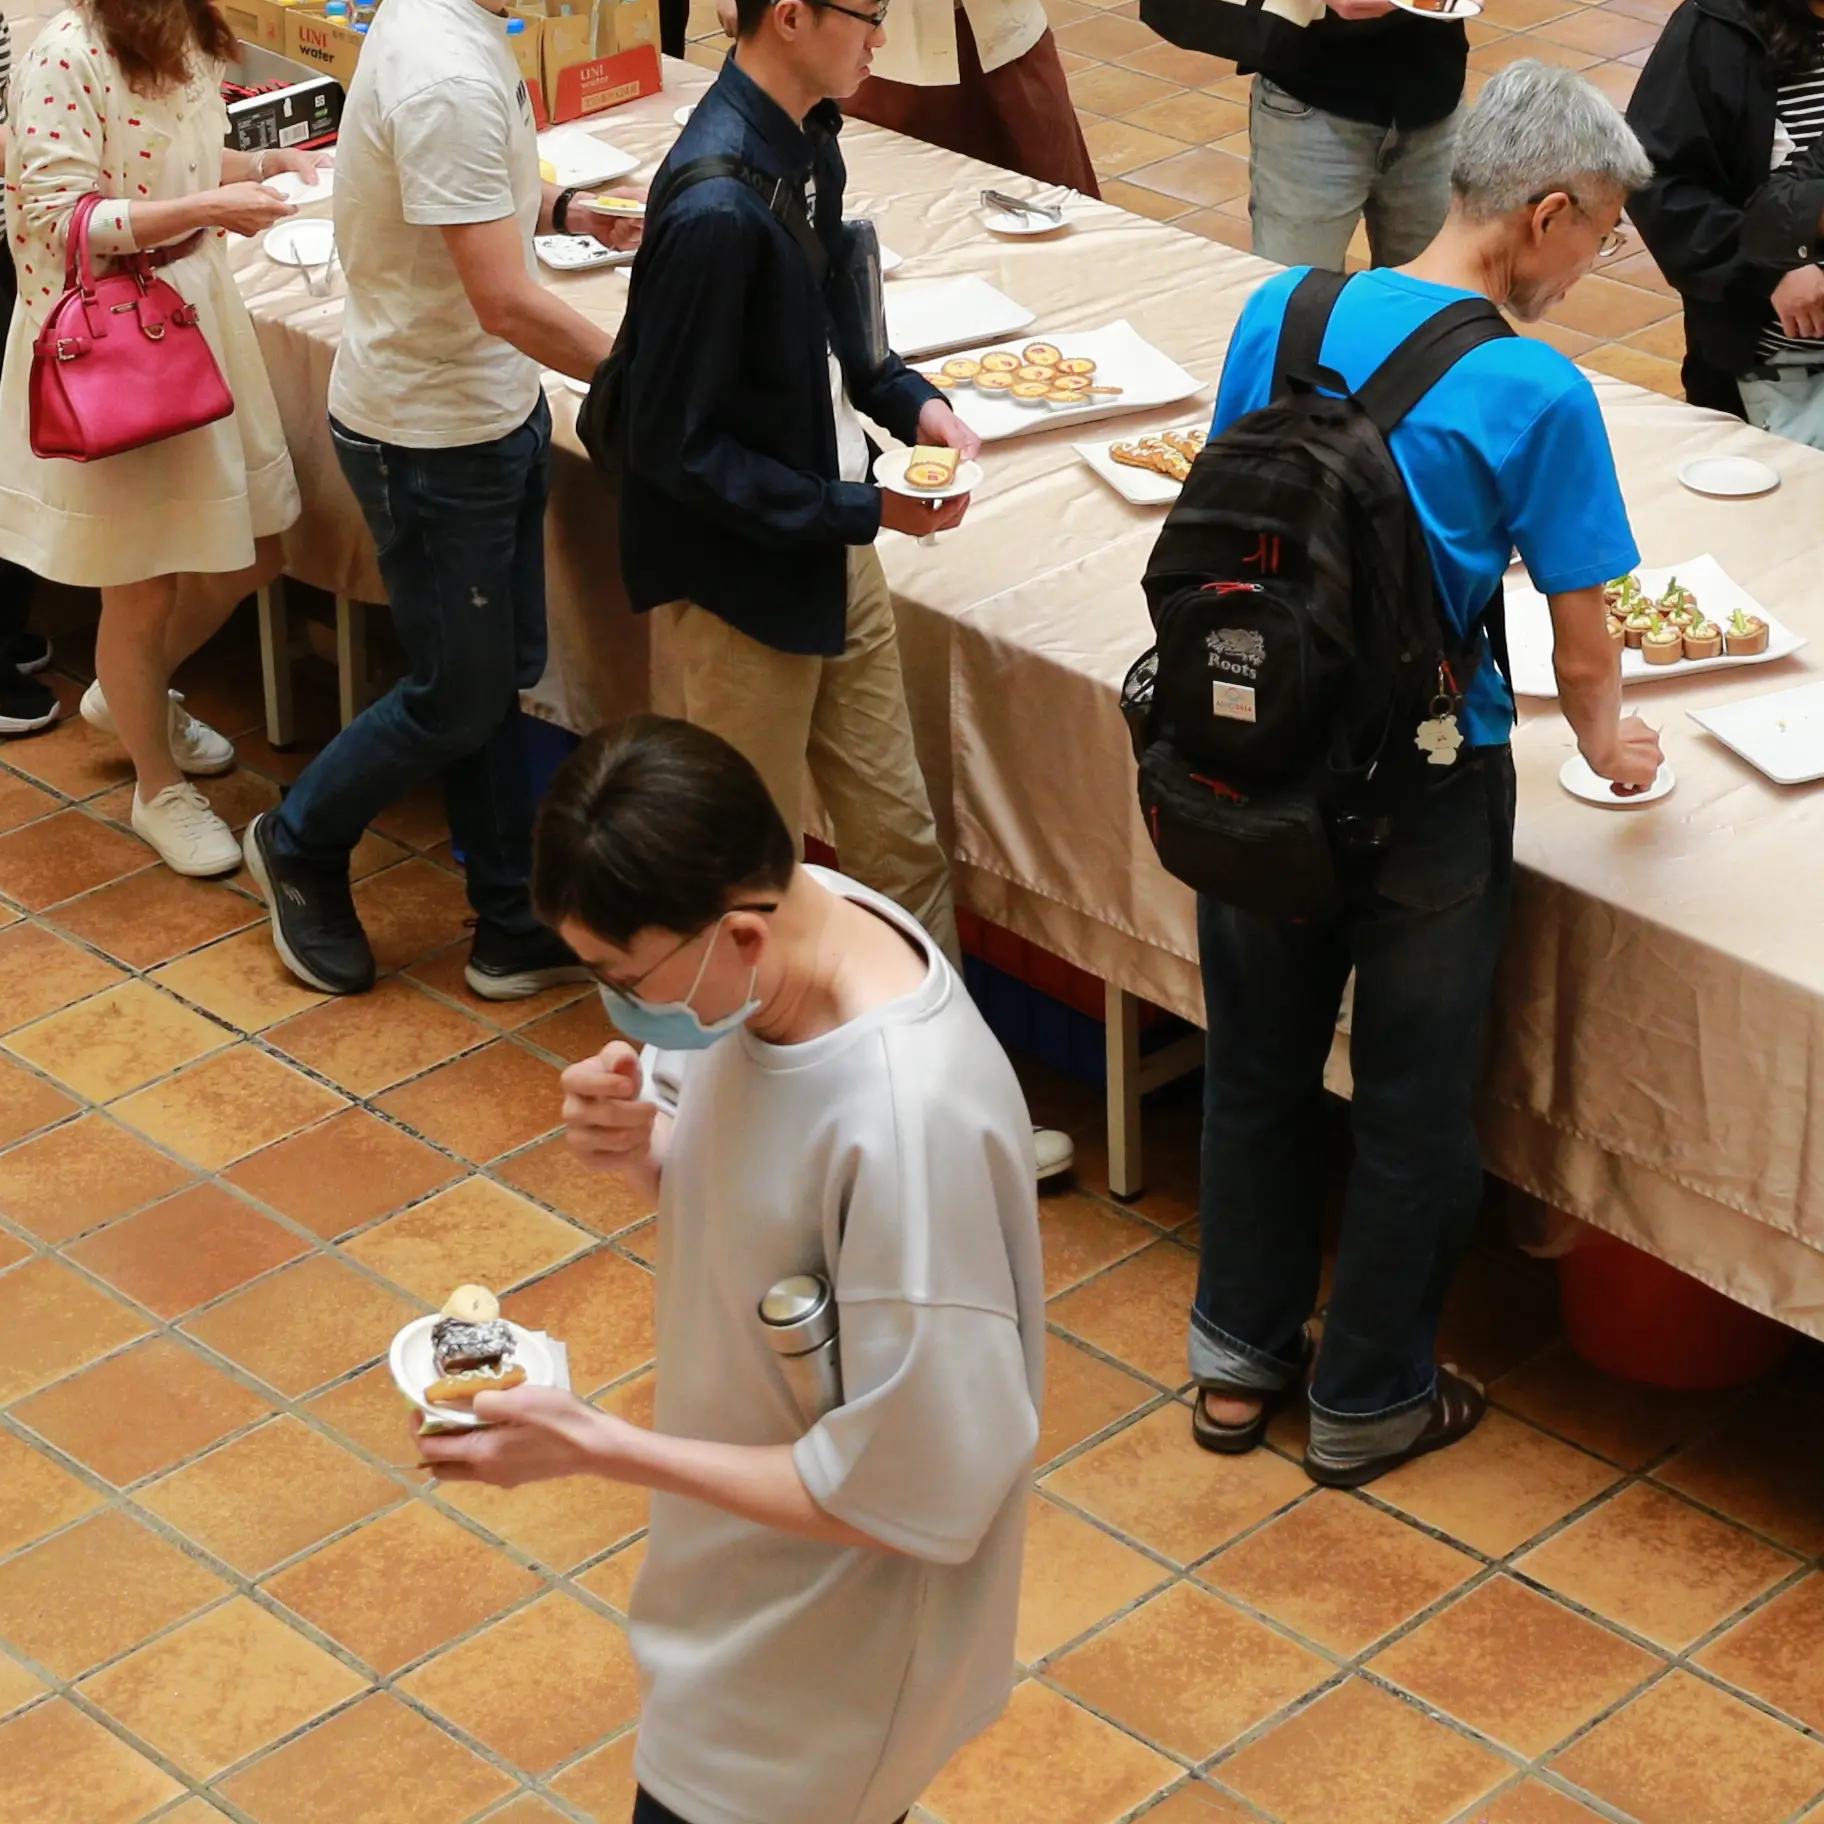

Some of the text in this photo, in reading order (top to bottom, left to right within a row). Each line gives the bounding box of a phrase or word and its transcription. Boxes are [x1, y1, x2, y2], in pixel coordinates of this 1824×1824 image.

[298, 25, 329, 49] UNI
[298, 43, 336, 64] water
[579, 63, 605, 82] UNI
[1207, 651, 1257, 680] Roots
